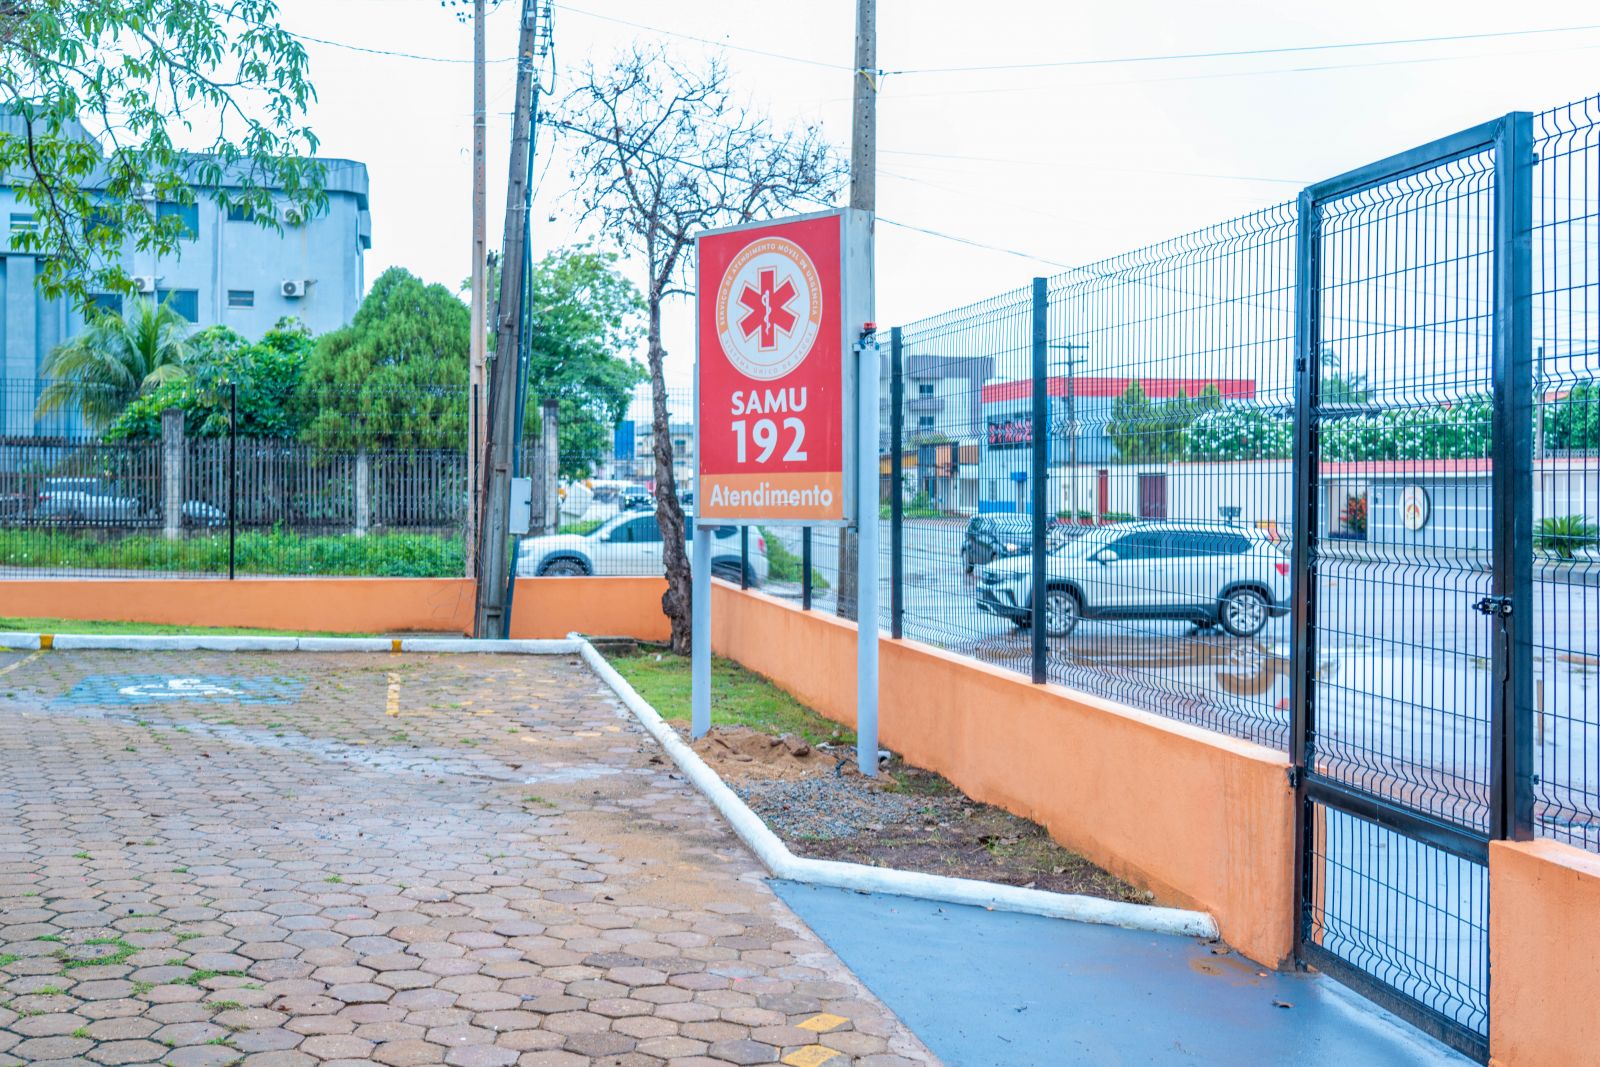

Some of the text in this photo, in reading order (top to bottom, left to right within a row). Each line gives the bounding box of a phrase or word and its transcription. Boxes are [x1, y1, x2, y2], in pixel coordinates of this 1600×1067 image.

[732, 243, 776, 273] ATENDIMENTO
[731, 387, 807, 415] SAMU
[731, 417, 807, 464] 192
[710, 482, 833, 507] Atendimento
